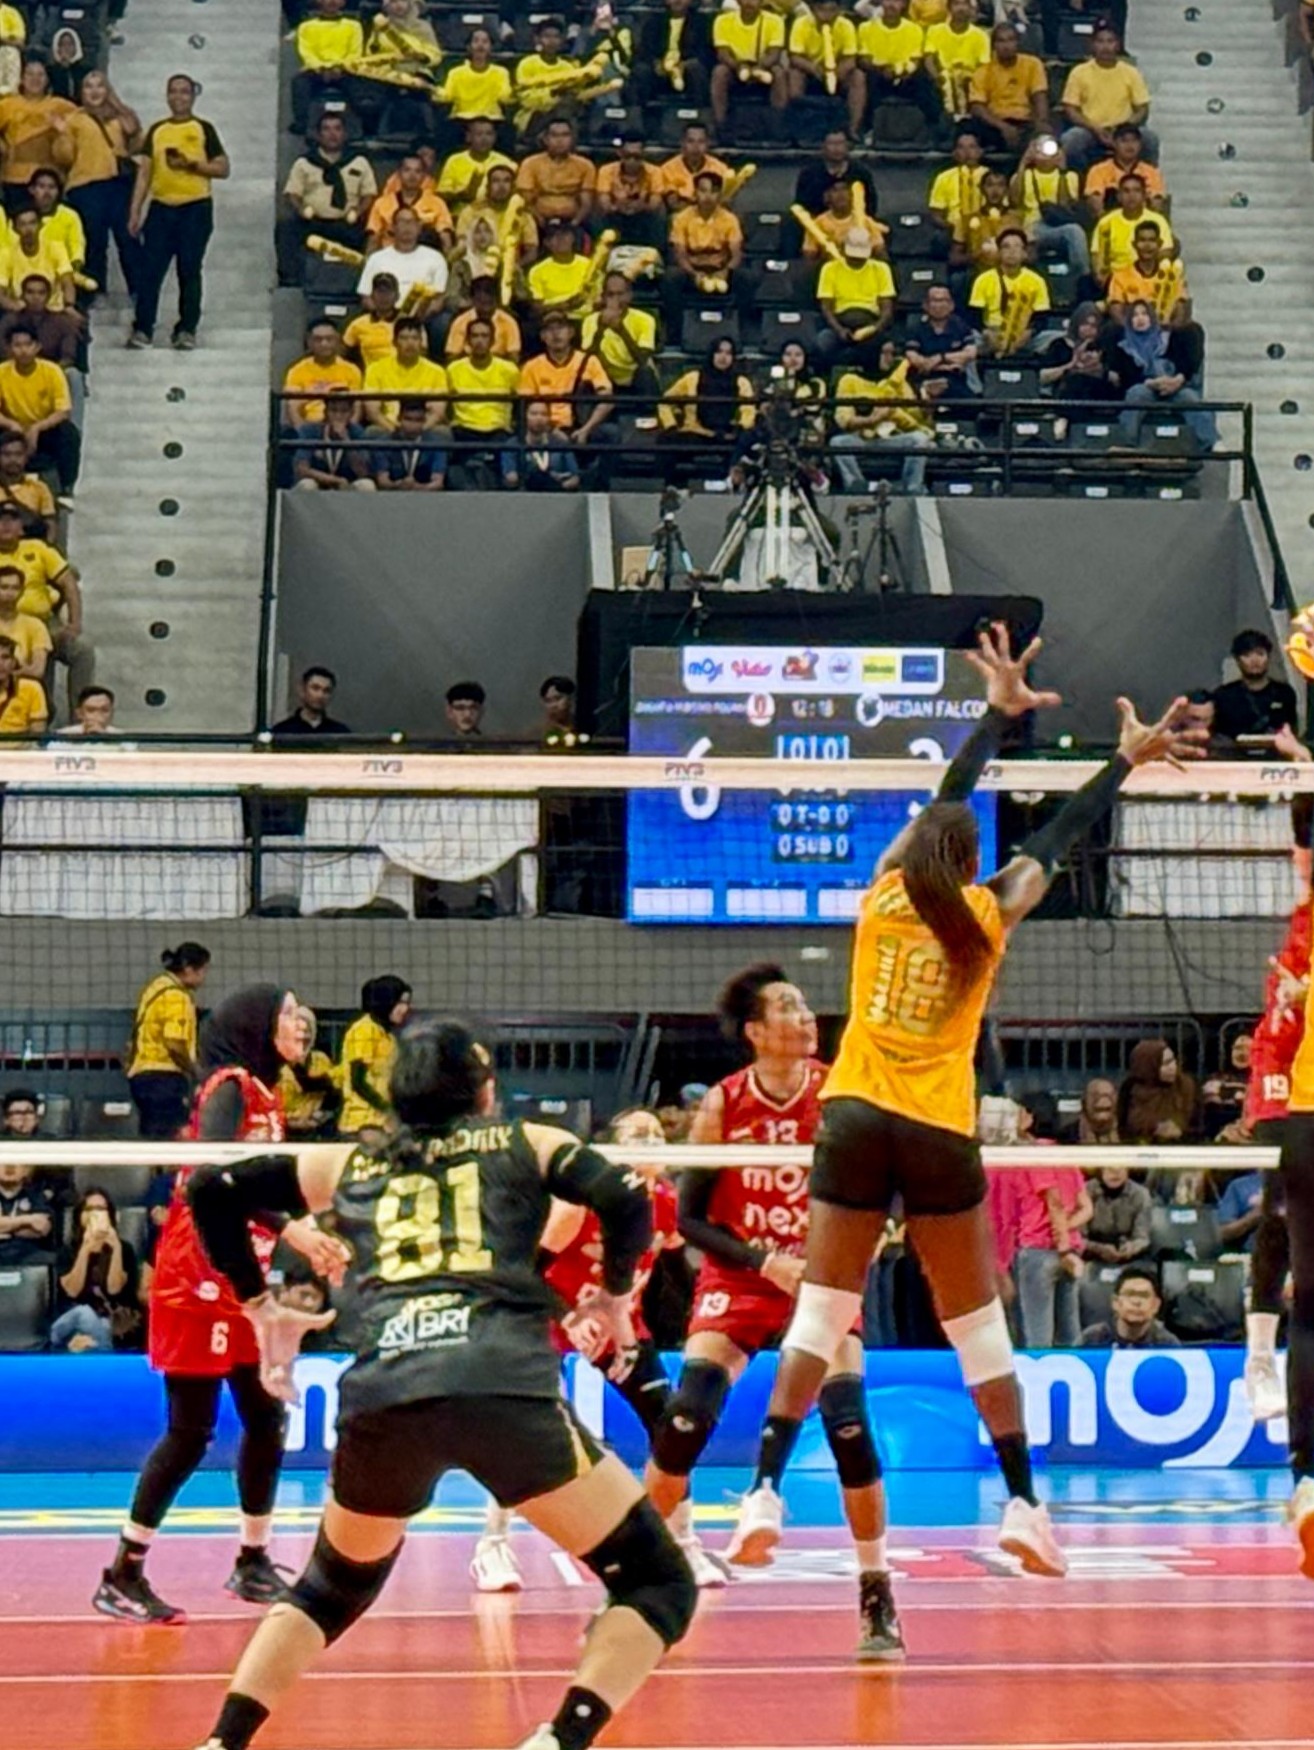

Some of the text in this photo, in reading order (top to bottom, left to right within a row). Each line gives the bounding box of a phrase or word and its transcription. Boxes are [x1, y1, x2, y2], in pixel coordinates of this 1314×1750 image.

[1263, 1074, 1289, 1101] 19
[376, 1161, 493, 1283] 81
[210, 1321, 231, 1356] 6
[417, 1306, 471, 1339] BRI
